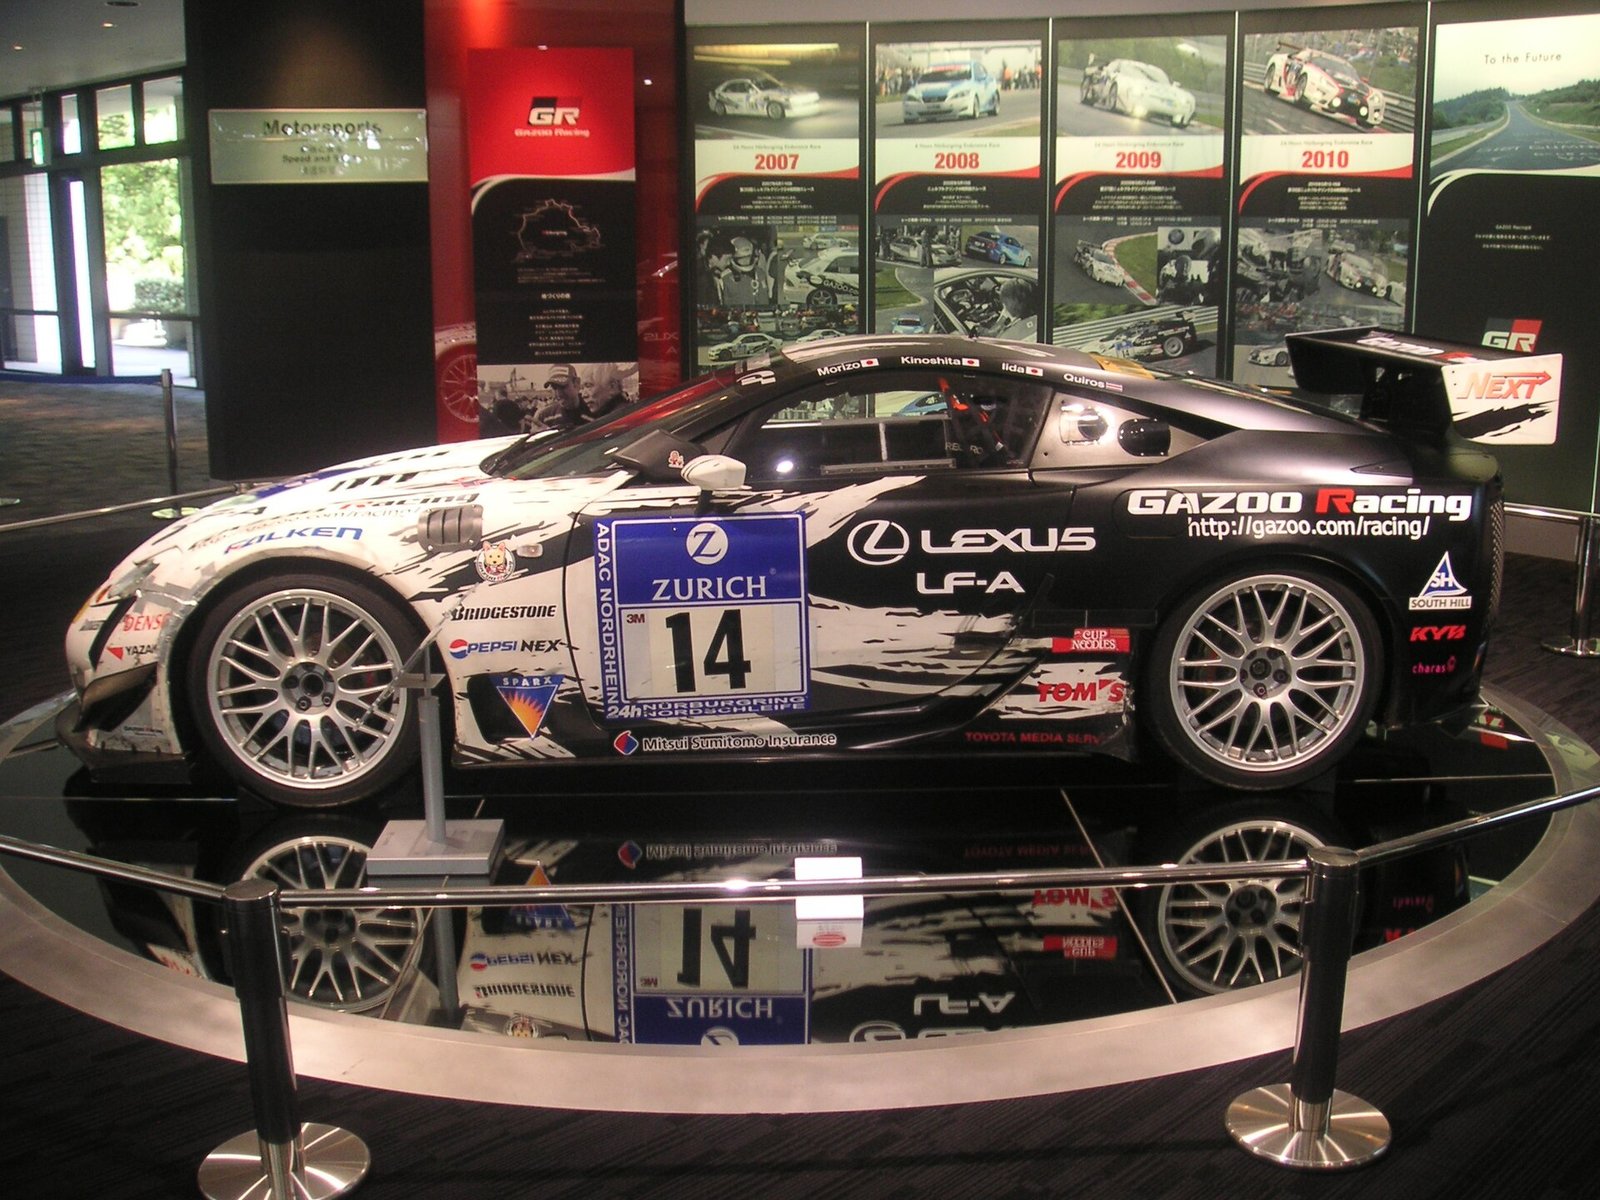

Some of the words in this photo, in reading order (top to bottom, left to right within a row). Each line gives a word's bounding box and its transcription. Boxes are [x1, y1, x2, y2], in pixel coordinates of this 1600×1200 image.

[1484, 54, 1496, 65] To
[1502, 53, 1519, 64] the
[1525, 52, 1562, 63] Future
[528, 107, 580, 125] GR
[263, 119, 382, 138] Motorsports
[754, 153, 800, 171] 2007
[934, 152, 980, 169] 2008
[1115, 151, 1162, 168] 2009
[1301, 150, 1349, 168] 2010
[1481, 331, 1537, 352] GR
[817, 361, 861, 377] Morizo
[901, 356, 962, 366] Kinoshita
[1063, 373, 1106, 389] Quiros
[1456, 371, 1551, 400] NEXT
[1126, 489, 1303, 515] GAZOO
[1315, 488, 1473, 521] Racing
[1188, 514, 1431, 540] http://gazoo.com/racing/
[223, 526, 363, 555] FALKEN
[921, 527, 1097, 554] LEXUS
[597, 522, 612, 582] ADAC
[652, 575, 767, 601] ZURICH
[916, 571, 1026, 595] LF-A
[1430, 572, 1454, 588] SH
[450, 602, 558, 621] BRIDGESTONE
[1411, 599, 1447, 609] SOUTH
[1450, 598, 1470, 608] HILL
[626, 613, 645, 624] 3M
[1082, 630, 1108, 640] CUP
[1410, 625, 1467, 642] KYB
[467, 640, 518, 654] PEPSI
[520, 639, 562, 653] NEX
[599, 588, 619, 705] NORDRHEIN
[665, 608, 752, 693] 14
[1072, 639, 1116, 650] NOODLES
[1412, 661, 1447, 675] charas
[502, 676, 553, 687] SPARX
[1038, 679, 1126, 703] TOM'S
[607, 705, 643, 720] 24h
[644, 703, 806, 718] NORDSCHLEIFE
[644, 696, 806, 711] NÜRBURGRING
[643, 736, 689, 751] Mitsui
[692, 735, 765, 751] Sumitomo
[767, 733, 837, 749] Insurance
[965, 732, 1016, 743] TOYOTA
[1020, 732, 1063, 744] MEDIA
[1066, 734, 1106, 746] SERV
